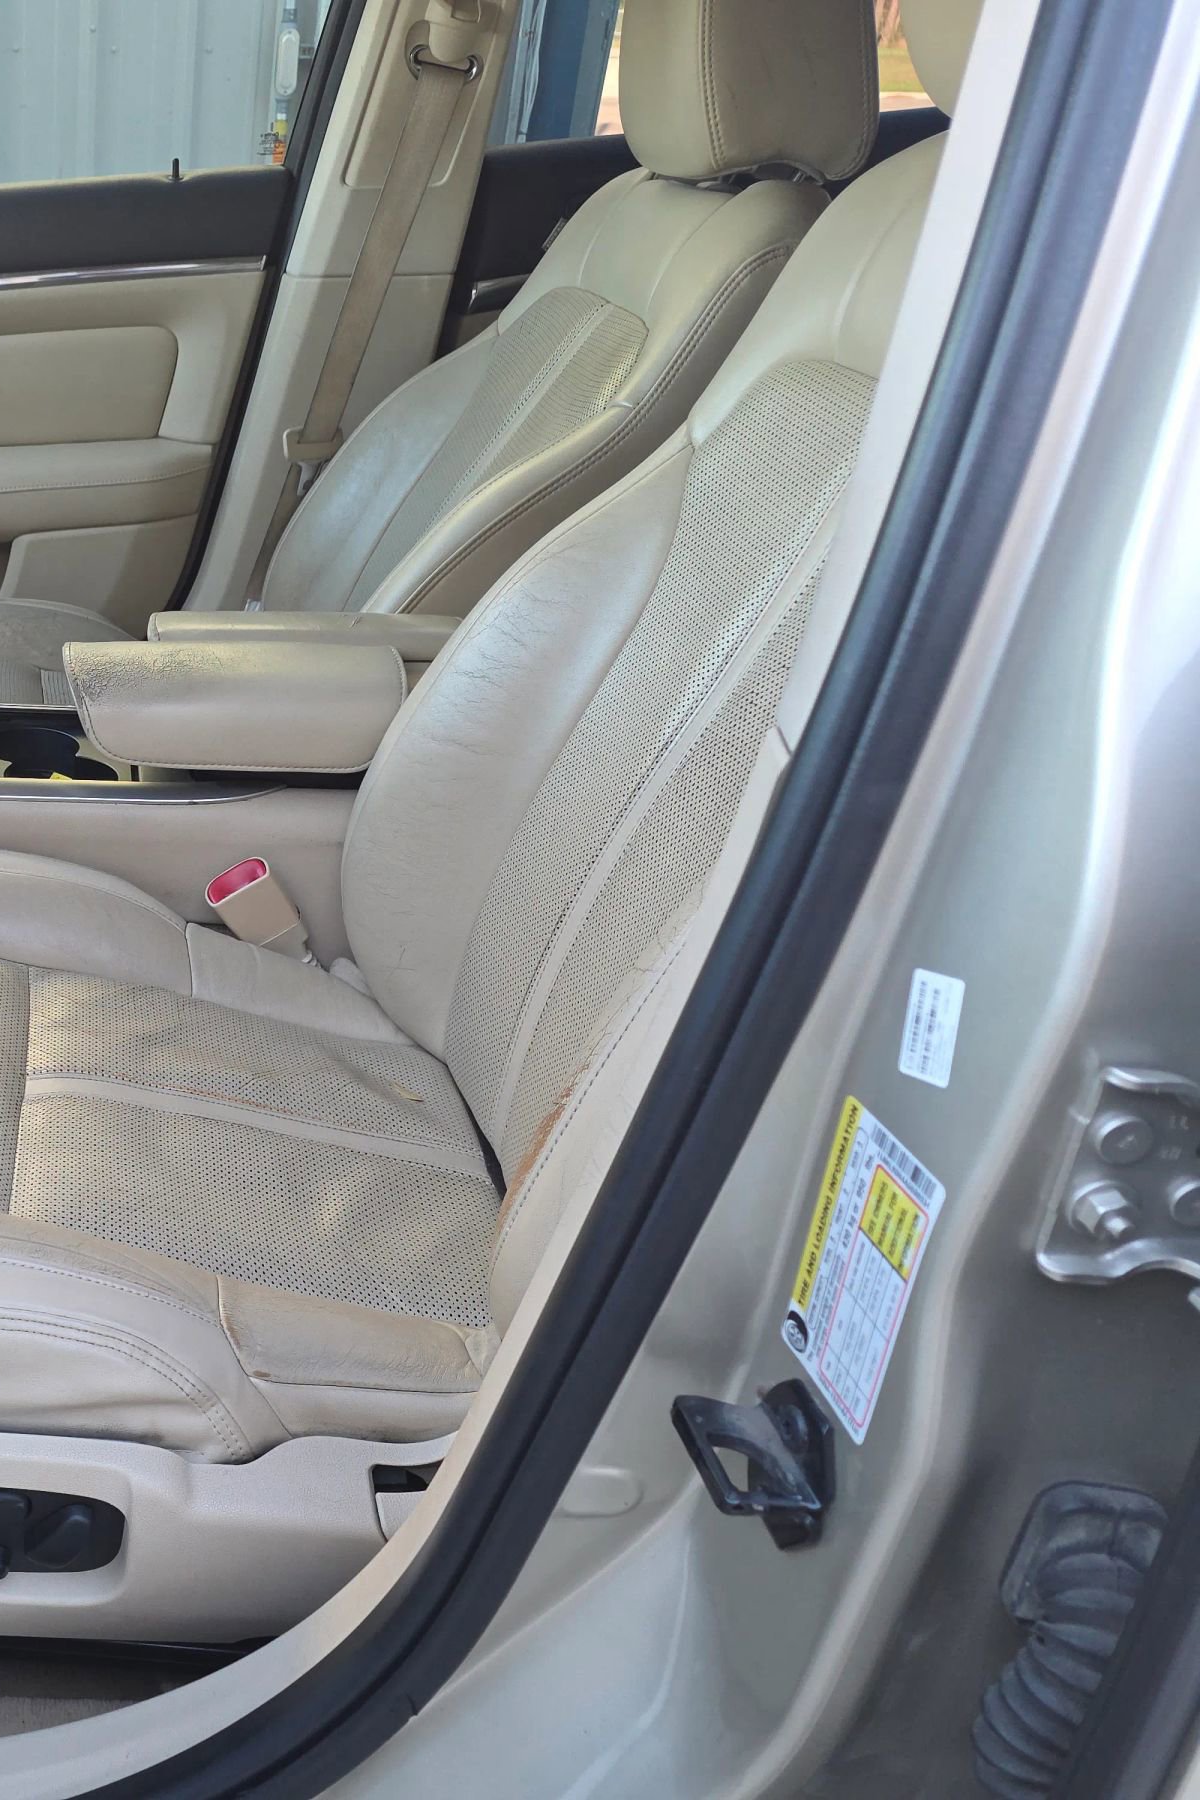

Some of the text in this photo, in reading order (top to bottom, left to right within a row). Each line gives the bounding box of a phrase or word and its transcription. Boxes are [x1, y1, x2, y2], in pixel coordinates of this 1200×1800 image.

[798, 1279, 810, 1306] TIRE
[806, 1251, 817, 1280] AND
[813, 1195, 833, 1251] LOADING
[828, 1104, 859, 1194] INFORMATION
[889, 1191, 898, 1209] FOR
